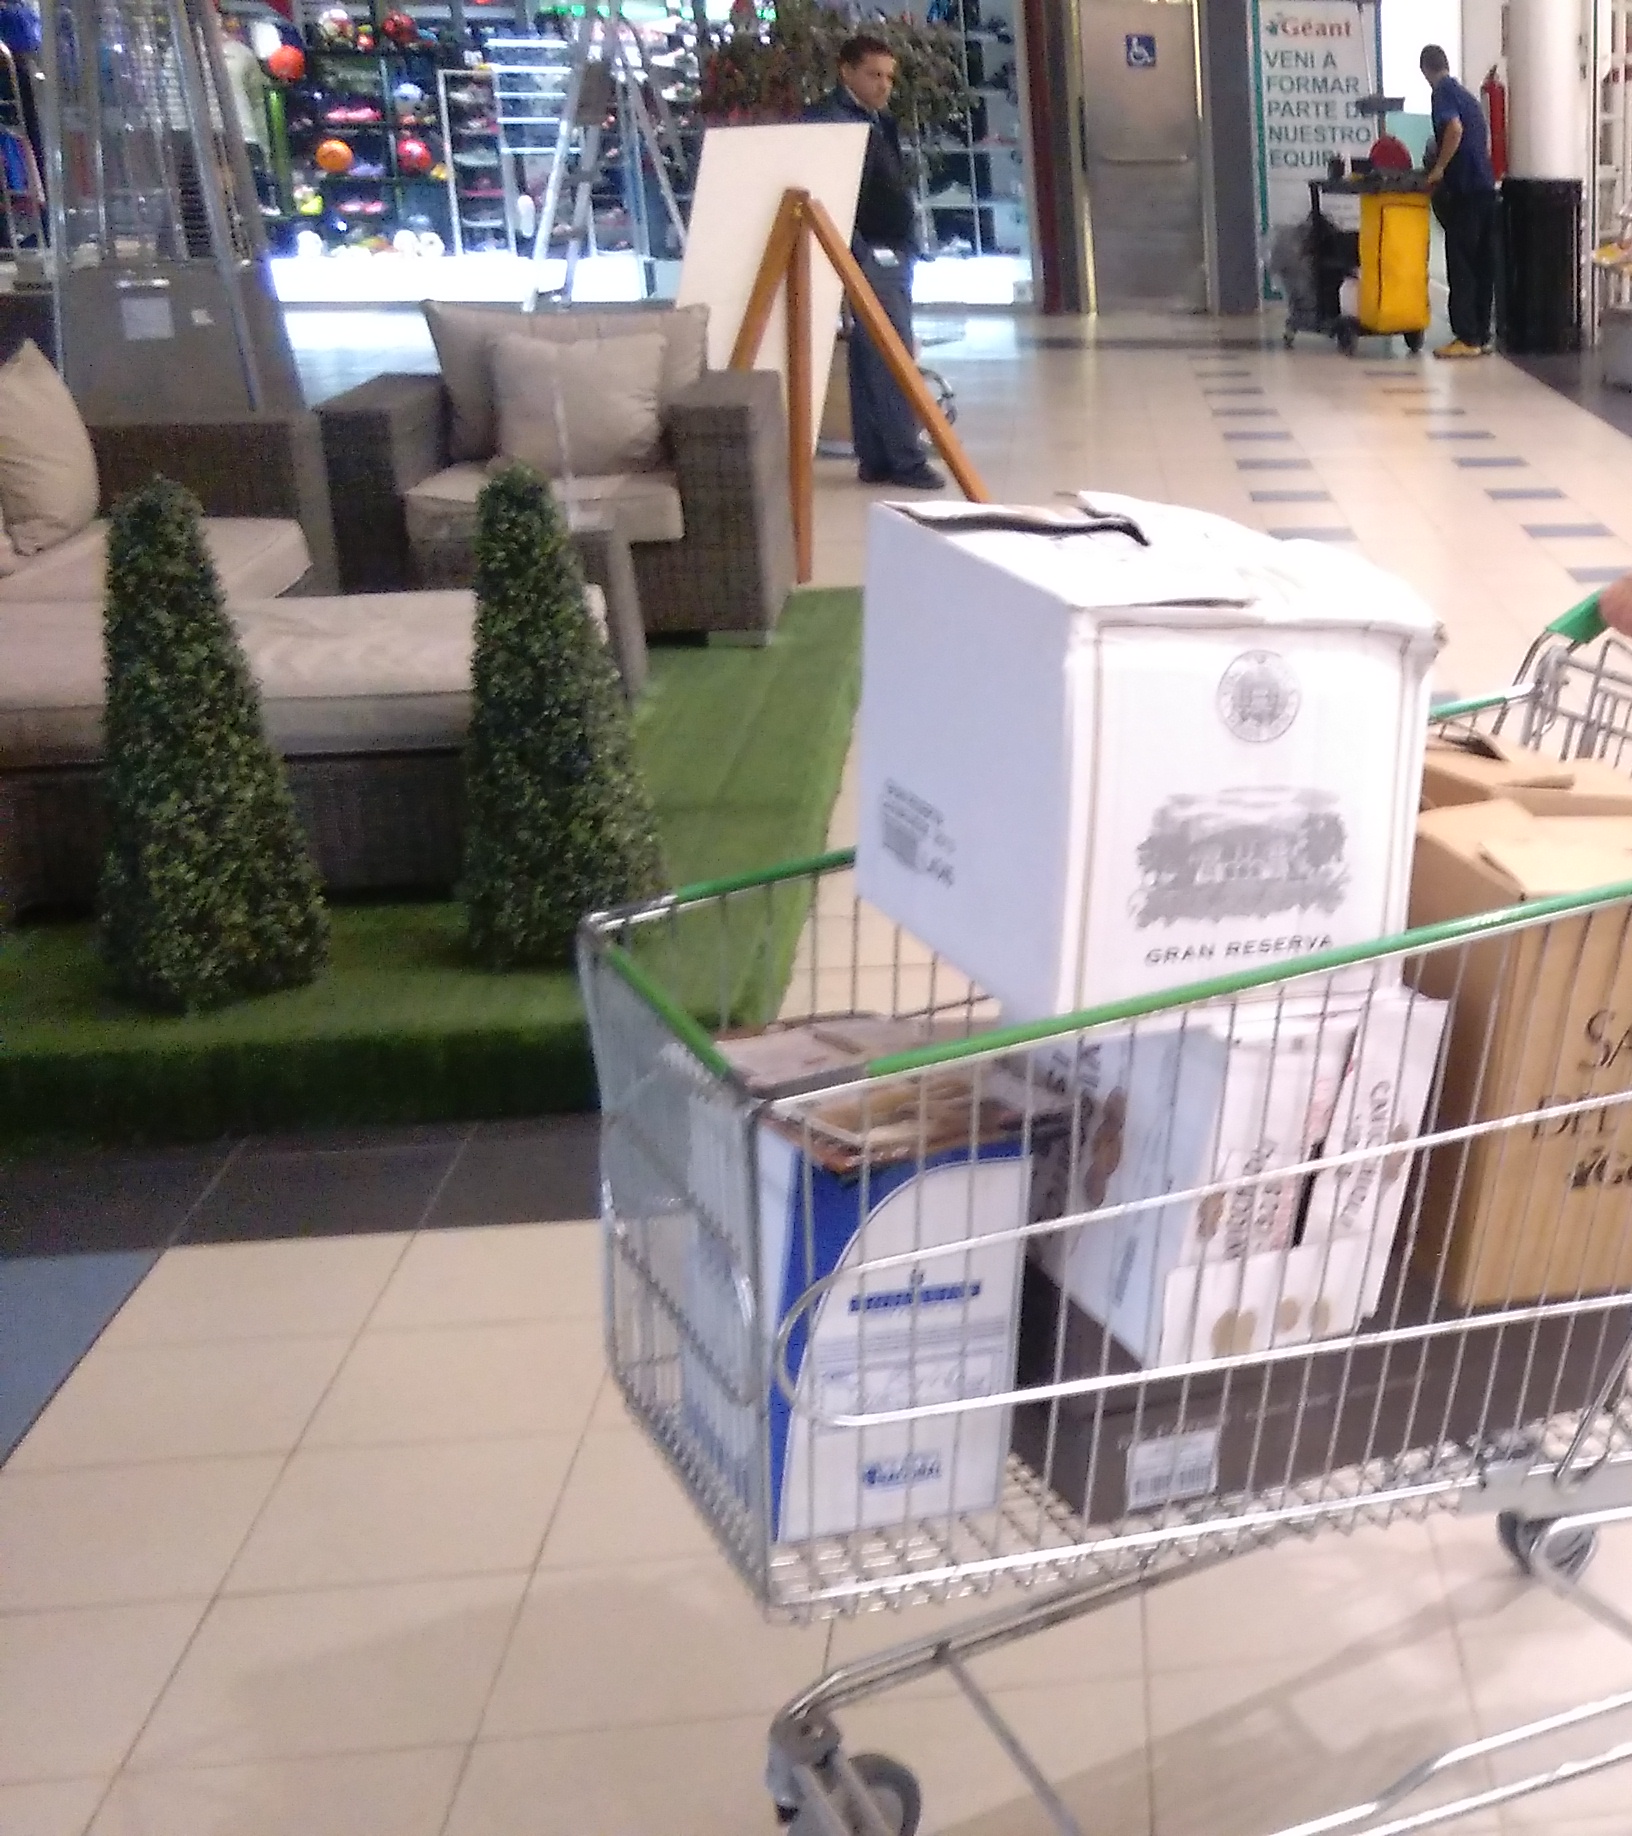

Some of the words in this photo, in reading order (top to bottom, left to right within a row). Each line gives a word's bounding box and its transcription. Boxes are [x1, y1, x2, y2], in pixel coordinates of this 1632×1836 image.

[1264, 50, 1315, 69] VENI
[1323, 51, 1337, 69] A
[1267, 75, 1360, 95] FORMAR
[1268, 100, 1337, 119] PARTE
[1269, 125, 1371, 144] NUESTRO
[1270, 149, 1341, 169] EQUIP
[1145, 943, 1215, 967] GRAN
[1225, 934, 1334, 957] RESERVA
